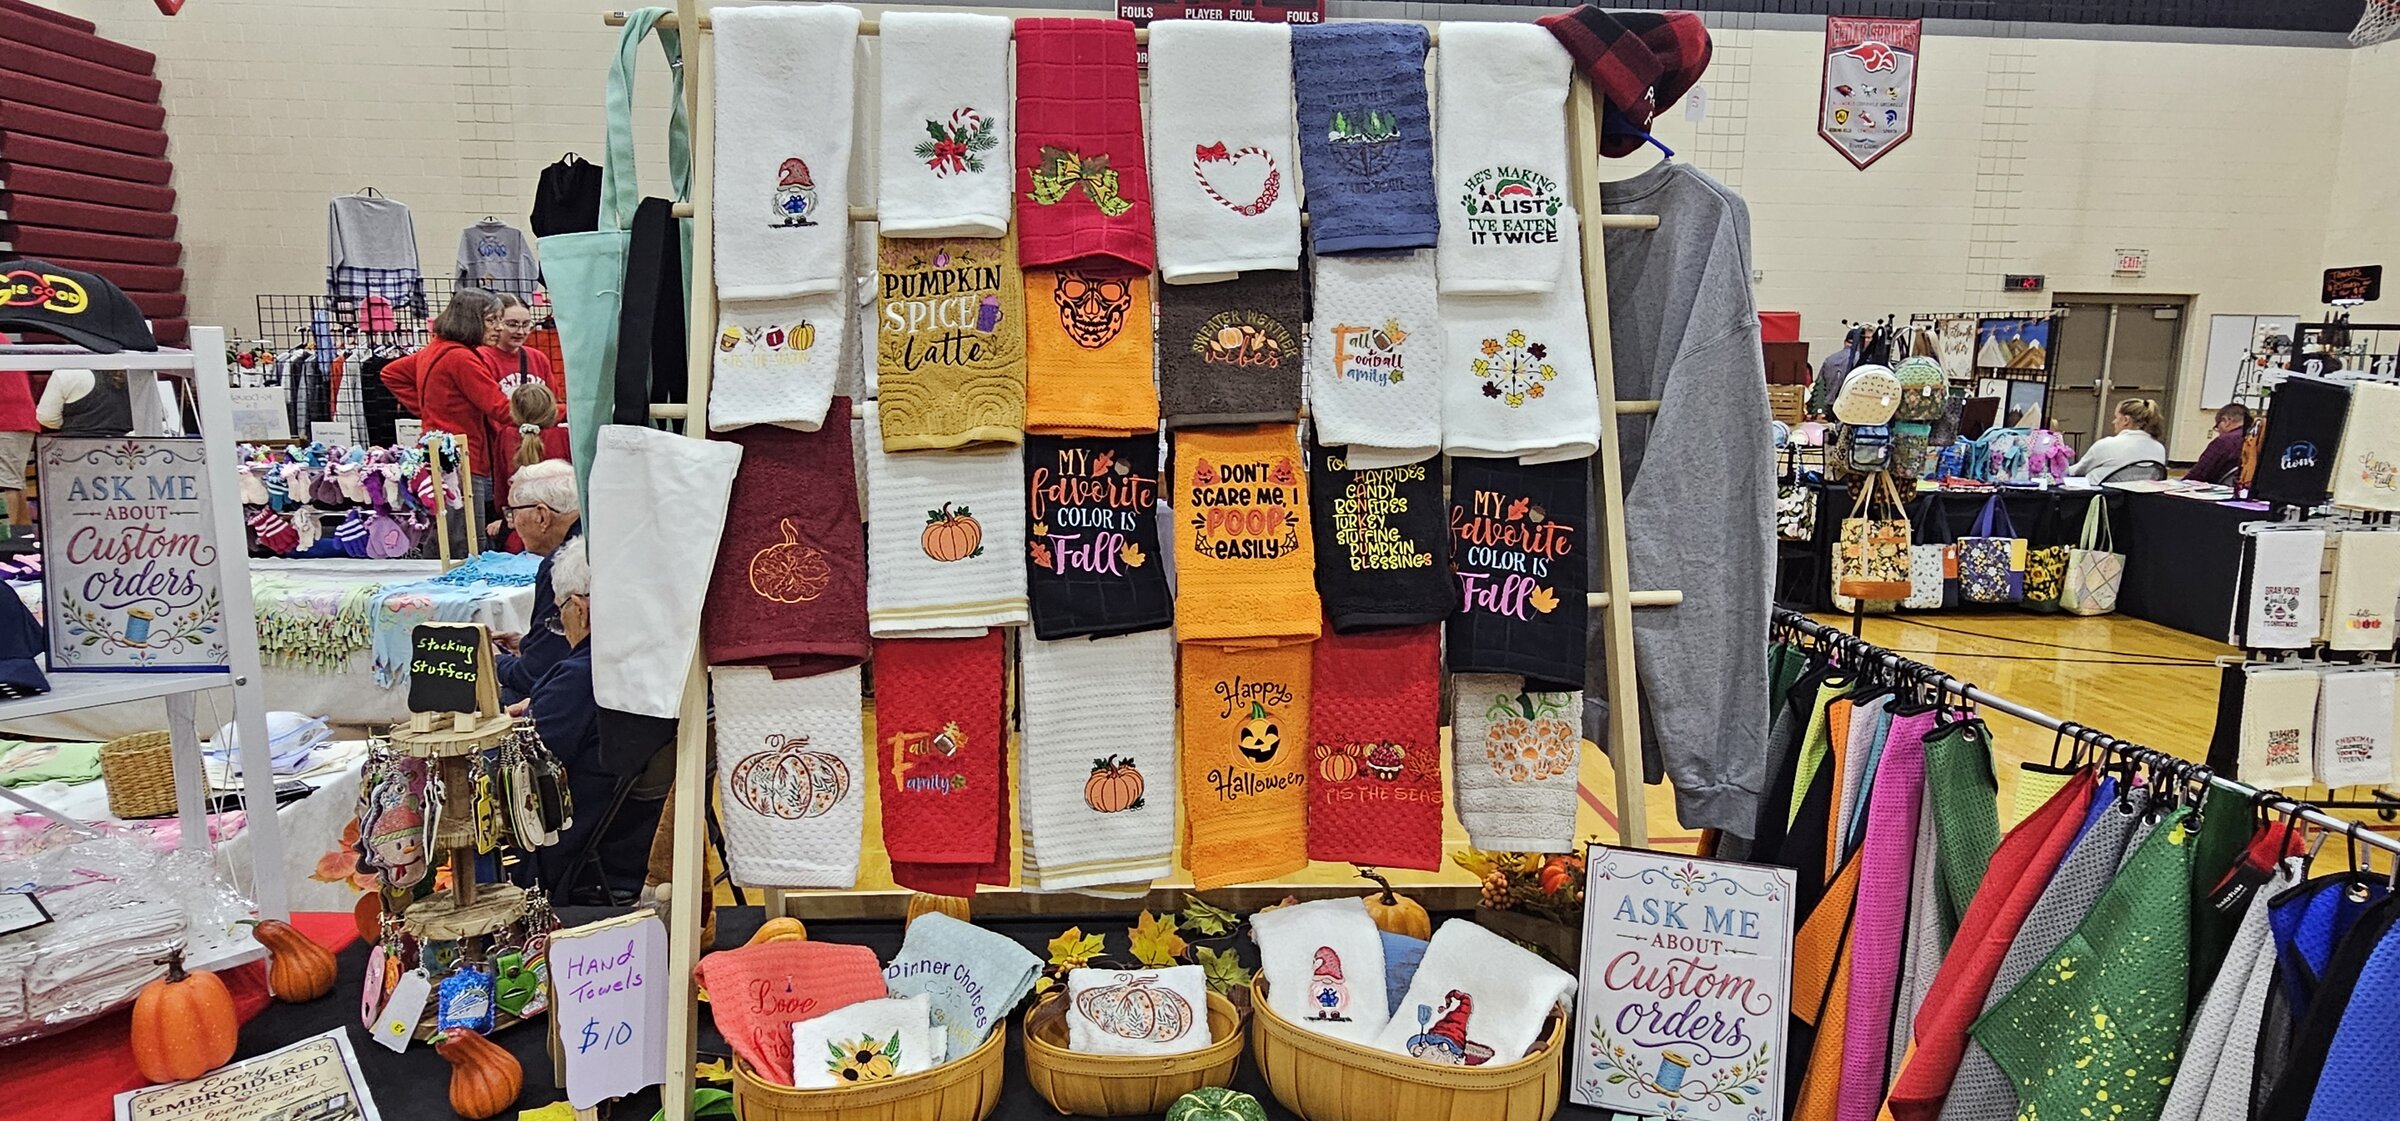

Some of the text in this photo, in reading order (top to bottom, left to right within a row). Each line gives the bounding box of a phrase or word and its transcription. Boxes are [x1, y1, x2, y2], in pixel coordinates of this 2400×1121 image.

[1121, 6, 1318, 23] FOULS PLAYER FOUL FOULS
[1464, 166, 1557, 193] HE'S MAKING
[1481, 200, 1545, 214] A LIST
[1472, 231, 1559, 245] IT TWICE
[1503, 218, 1556, 232] EATEN
[883, 265, 1001, 299] PUMPKIN
[884, 294, 977, 334] SPICE
[1193, 309, 1299, 358] SWEATER WEATHER
[1205, 335, 1282, 368] vibes
[1058, 448, 1091, 477] MY
[1220, 461, 1270, 483] DON'T
[1354, 463, 1426, 485] HAYRIDES
[67, 475, 199, 501] ASK ME
[1031, 467, 1157, 520] favorite
[1293, 488, 1298, 505] I
[1346, 482, 1396, 499] CANDY
[104, 506, 168, 520] ABOUT
[1057, 507, 1137, 531] COLOR IS
[1334, 498, 1407, 515] BONFIRES
[1474, 490, 1506, 519] MY
[1206, 507, 1285, 538] POOP
[1332, 513, 1385, 530] TURKEY
[1336, 527, 1401, 545] STUFFING
[1449, 505, 1574, 561] favorite
[66, 522, 217, 566] Custom
[1047, 532, 1124, 576] Fall
[1350, 539, 1414, 557] PUMPKIN
[1350, 552, 1432, 571] BLESSINGS
[1468, 546, 1550, 578] COLOR IS
[1456, 574, 1536, 622] Fall
[417, 637, 474, 664] Stocking
[412, 660, 477, 682] Stuffers
[1215, 675, 1293, 719] Happy
[1207, 765, 1305, 801] Halloween
[1357, 785, 1389, 803] THE
[1613, 895, 1760, 939] ASK ME
[1651, 932, 1723, 956] ABOUT
[569, 966, 643, 1003] Towels
[749, 979, 818, 1016] Love
[888, 960, 987, 1029] Dinner Choices
[1604, 951, 1772, 1016] Custom
[577, 1017, 632, 1054] $10
[150, 1055, 329, 1117] EMBROIDERED
[199, 1065, 270, 1093] Every
[252, 1075, 319, 1106] created
[178, 1099, 221, 1115] ITEM
[230, 1086, 266, 1099] YOU
